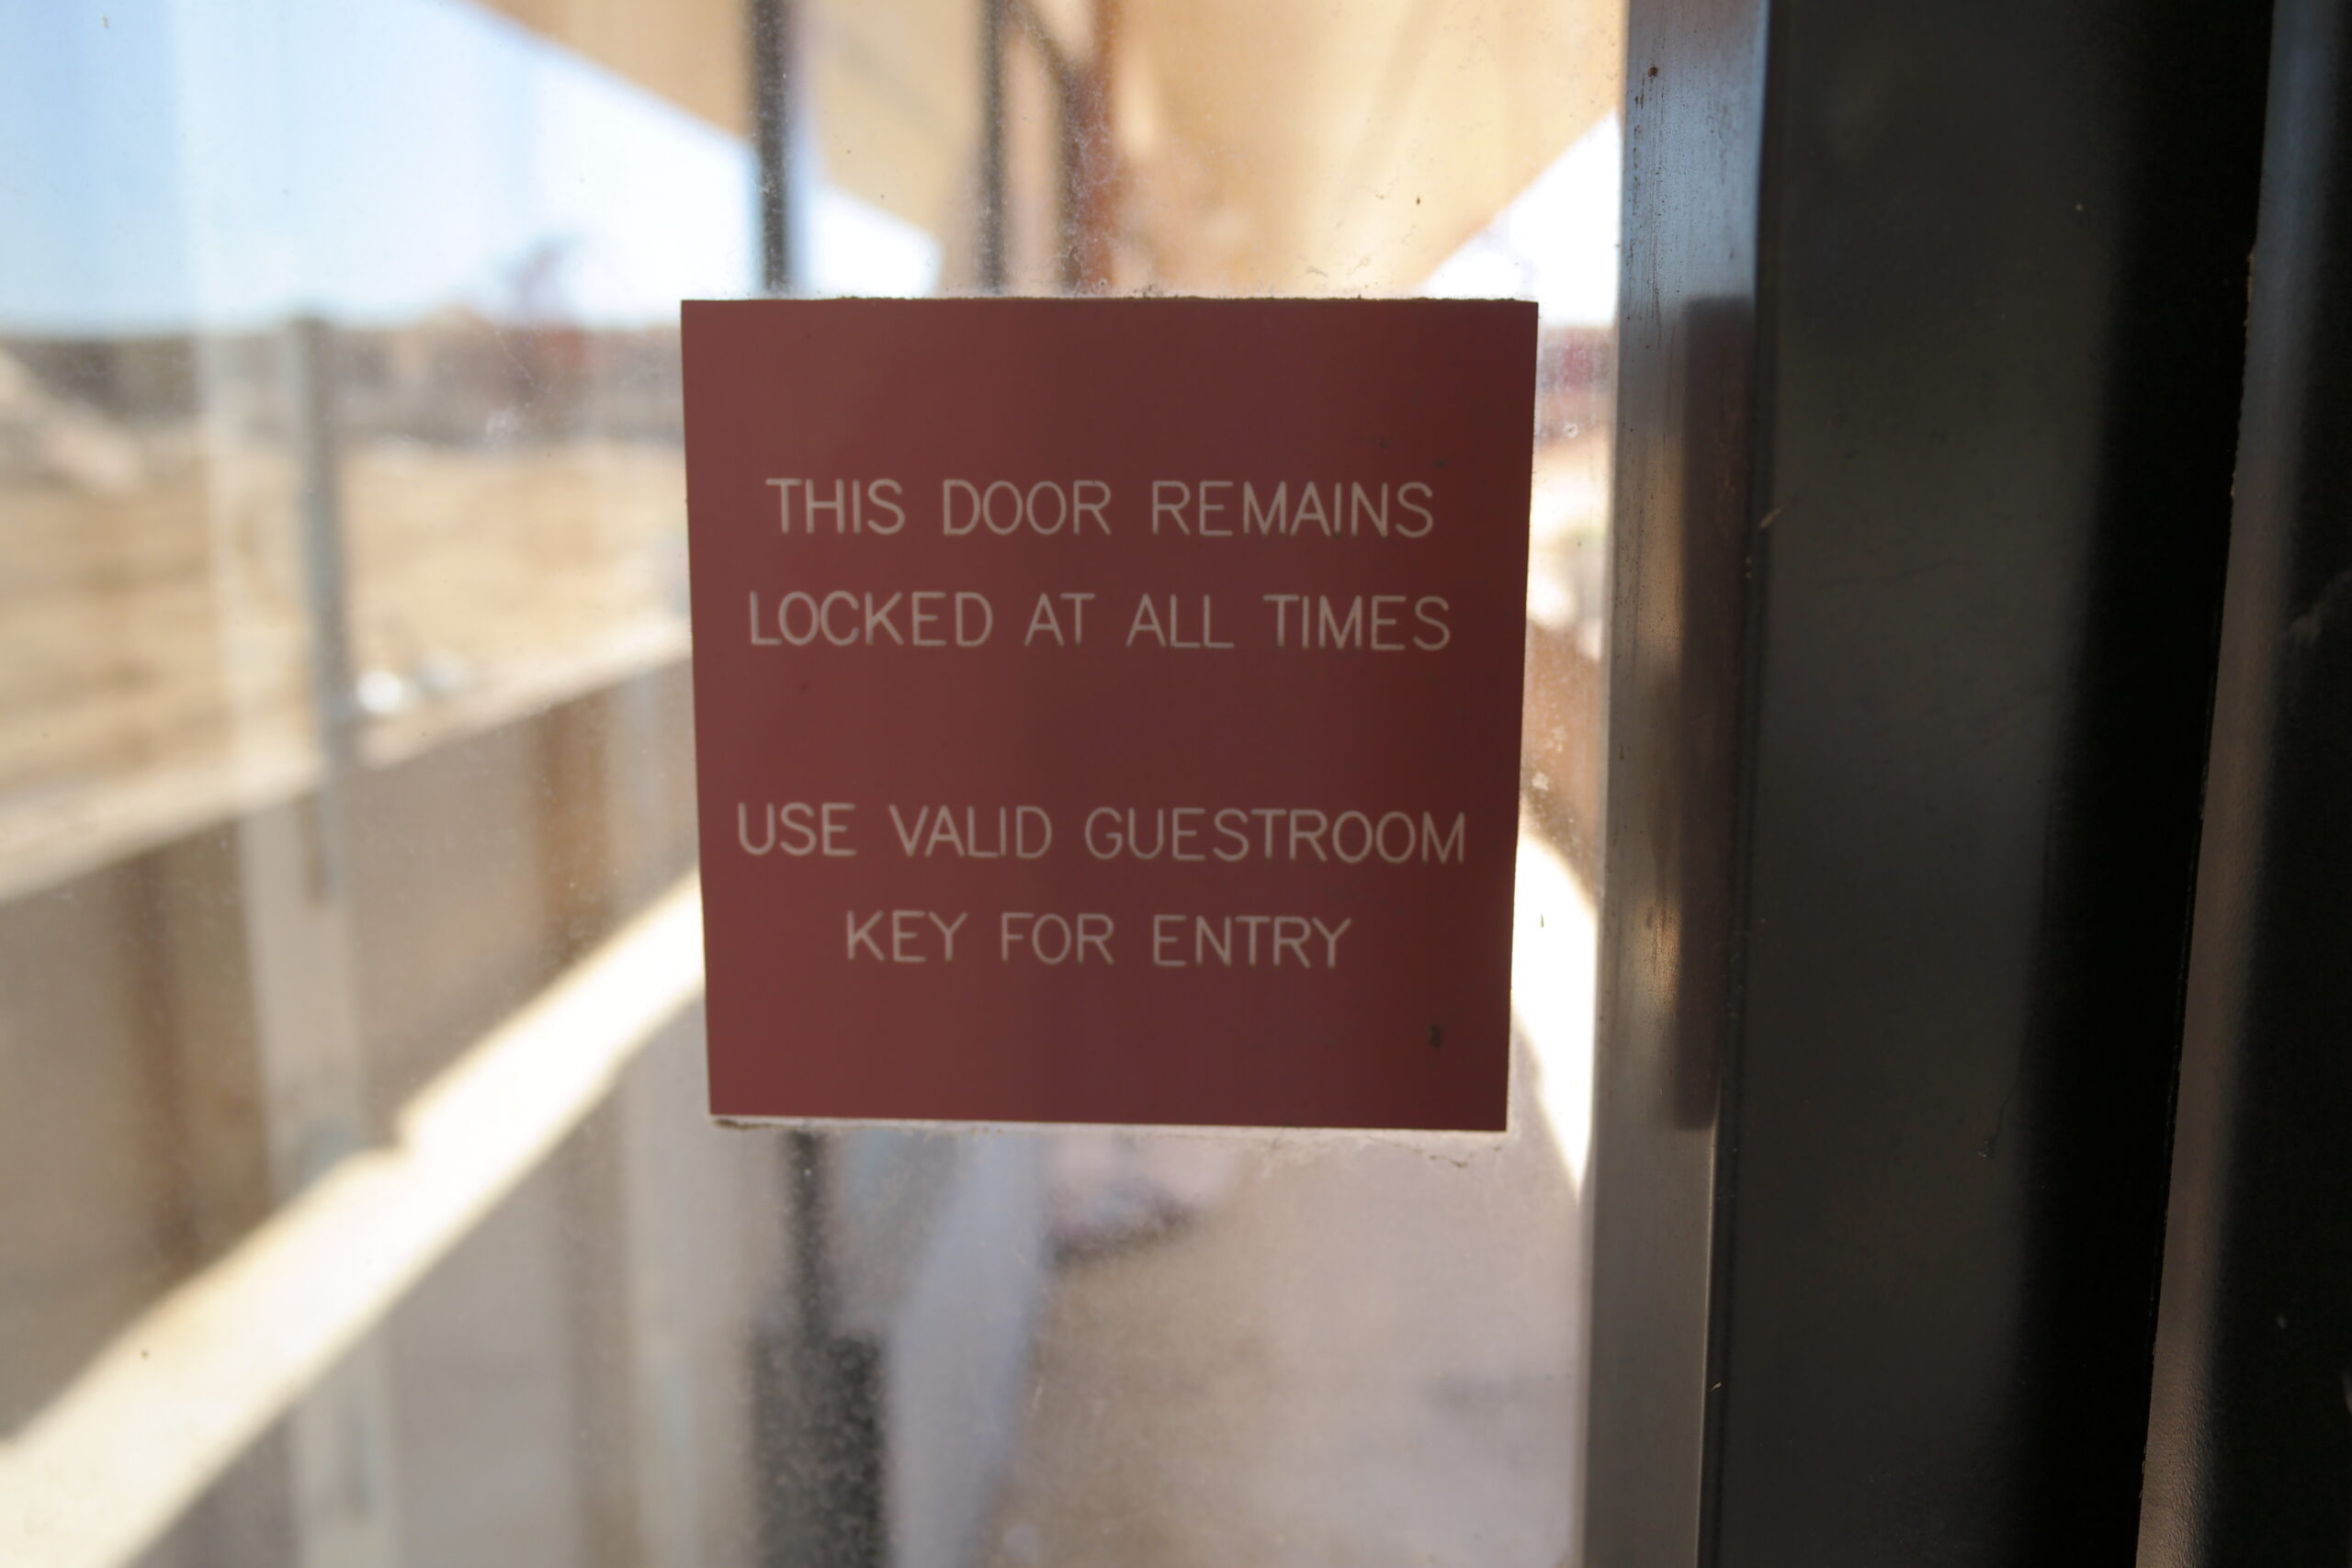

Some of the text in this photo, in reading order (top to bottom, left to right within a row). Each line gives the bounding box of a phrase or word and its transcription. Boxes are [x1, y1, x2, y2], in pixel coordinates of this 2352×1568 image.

[765, 478, 1435, 539] THIS DOOR REMAINS
[750, 591, 1452, 652] LOCKED AT ALL TIMES
[738, 802, 1466, 865] USE VALID GUESTROOM
[847, 910, 1352, 969] KEY FOR ENTRY
